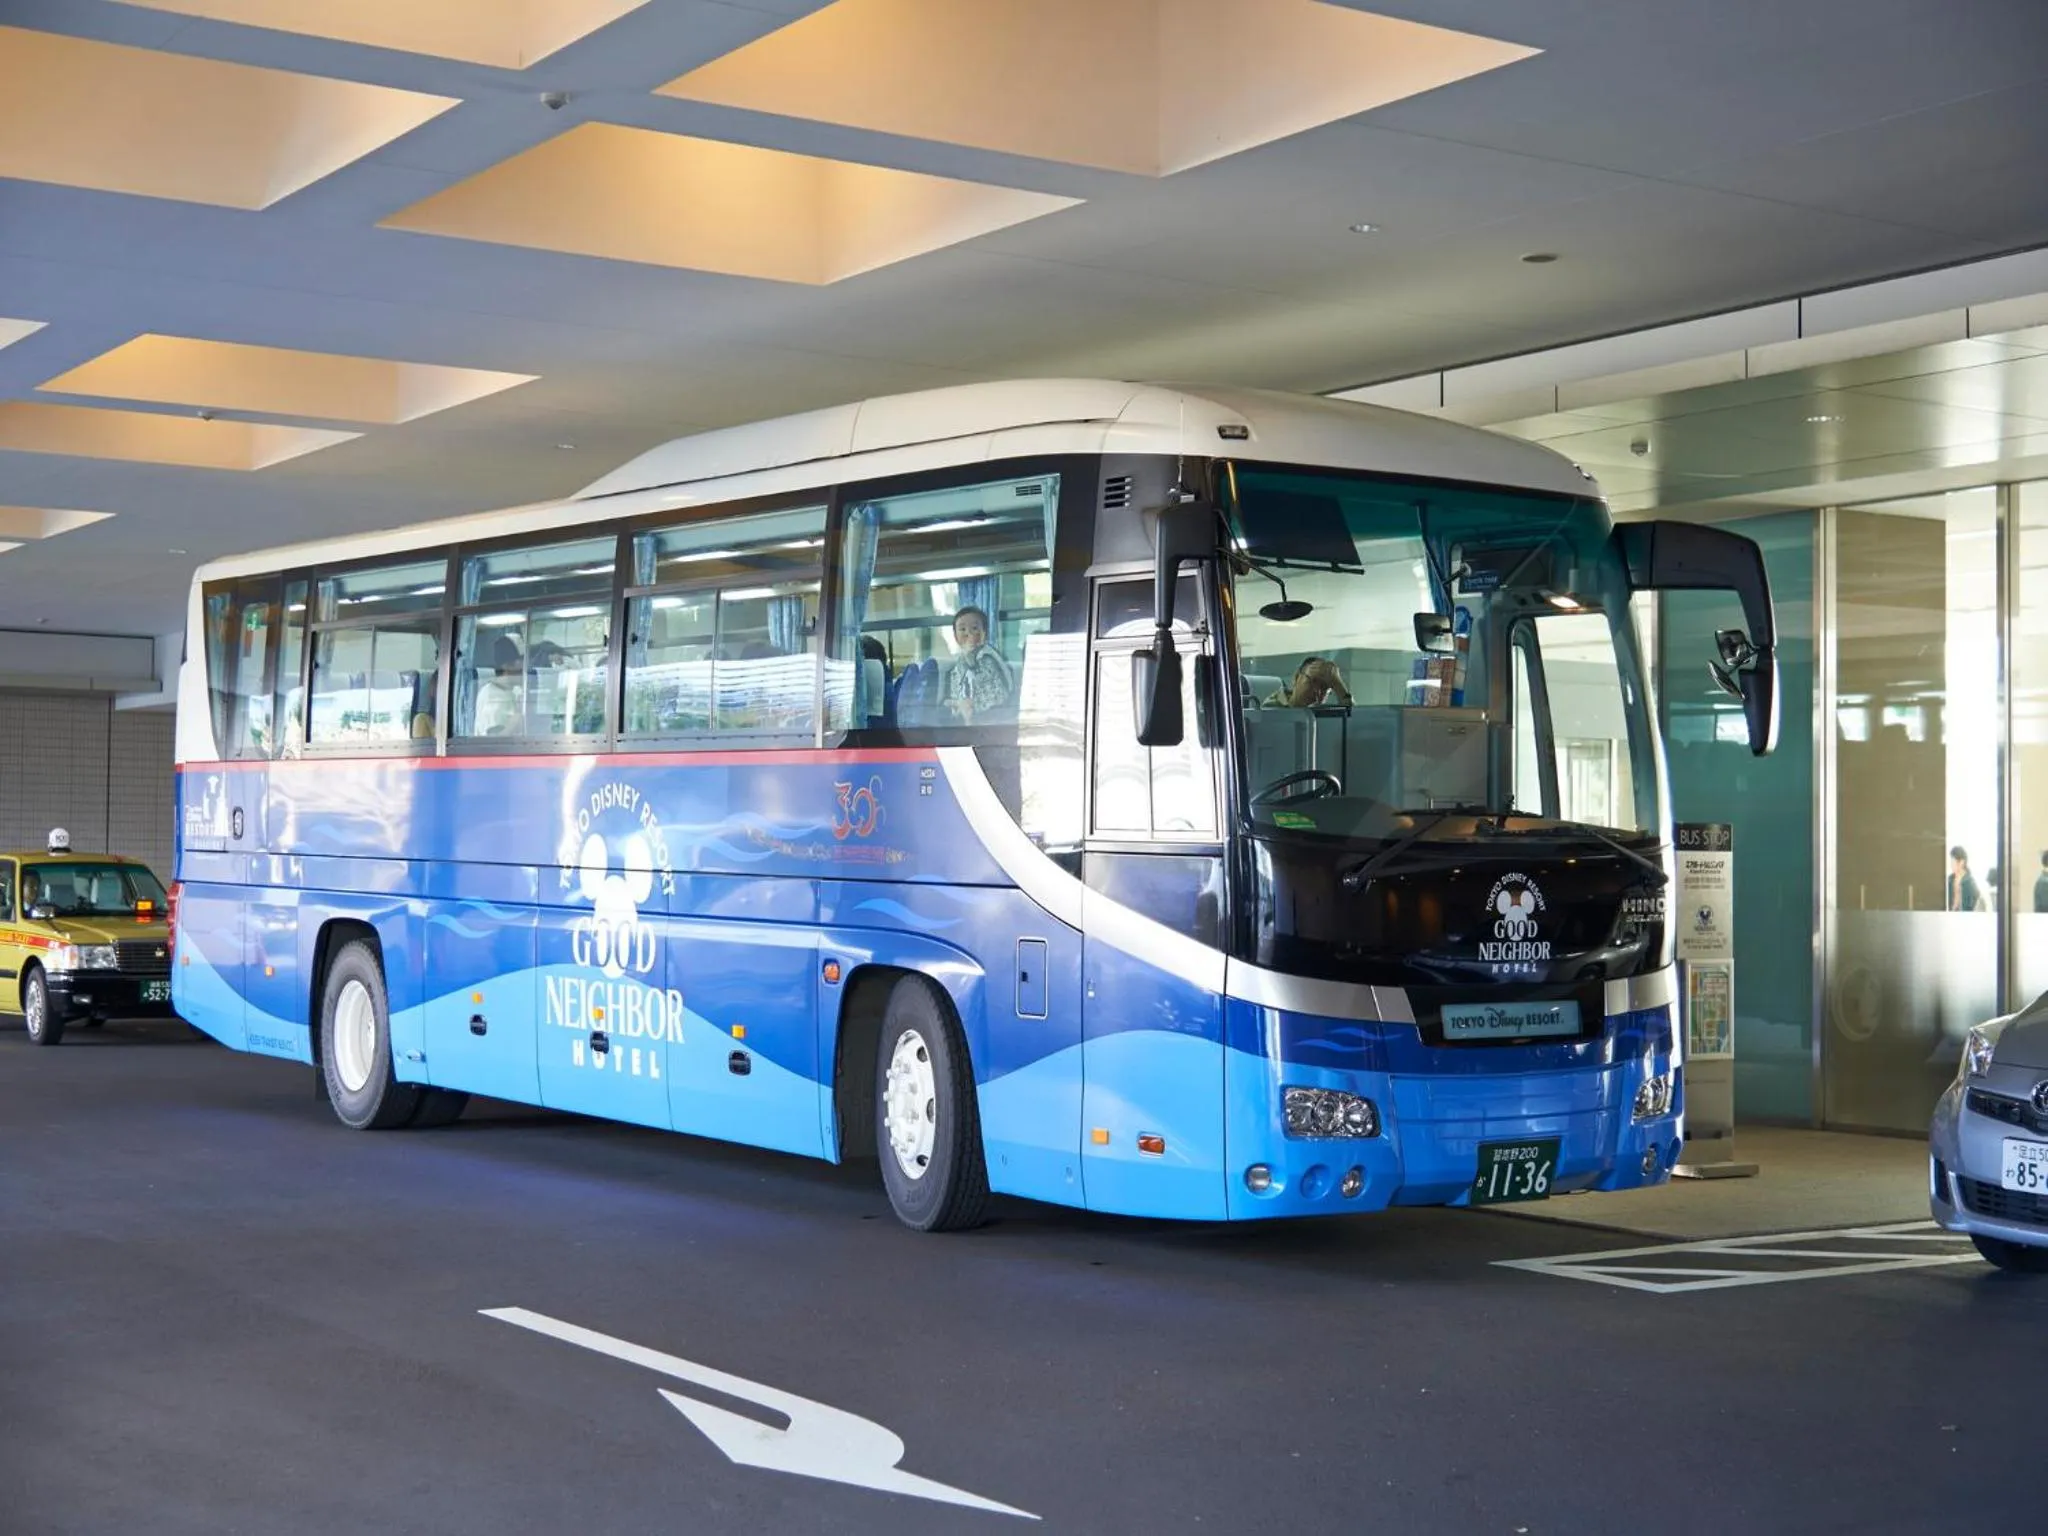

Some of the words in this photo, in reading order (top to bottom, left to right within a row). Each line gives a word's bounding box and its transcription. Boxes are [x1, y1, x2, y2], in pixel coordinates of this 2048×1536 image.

[591, 782, 640, 817] DISNEY
[1680, 829, 1700, 845] BUS
[1703, 830, 1730, 845] STOP
[1485, 881, 1501, 911] TOKYO
[1501, 872, 1527, 885] DISNEY
[1527, 879, 1547, 911] RESORT
[1621, 897, 1667, 913] HINO
[1494, 919, 1539, 939] GOOD
[572, 917, 656, 973] GOOD
[1478, 942, 1551, 961] NEIGHBOR
[1491, 963, 1537, 974] HOTEL
[545, 975, 684, 1044] NEIGHBOR
[1451, 1015, 1485, 1029] TOKYO
[1485, 1006, 1524, 1033] Disney
[1526, 1012, 1561, 1026] RESORT
[572, 1039, 660, 1080] HOTEL
[2018, 1161, 2048, 1188] 85-
